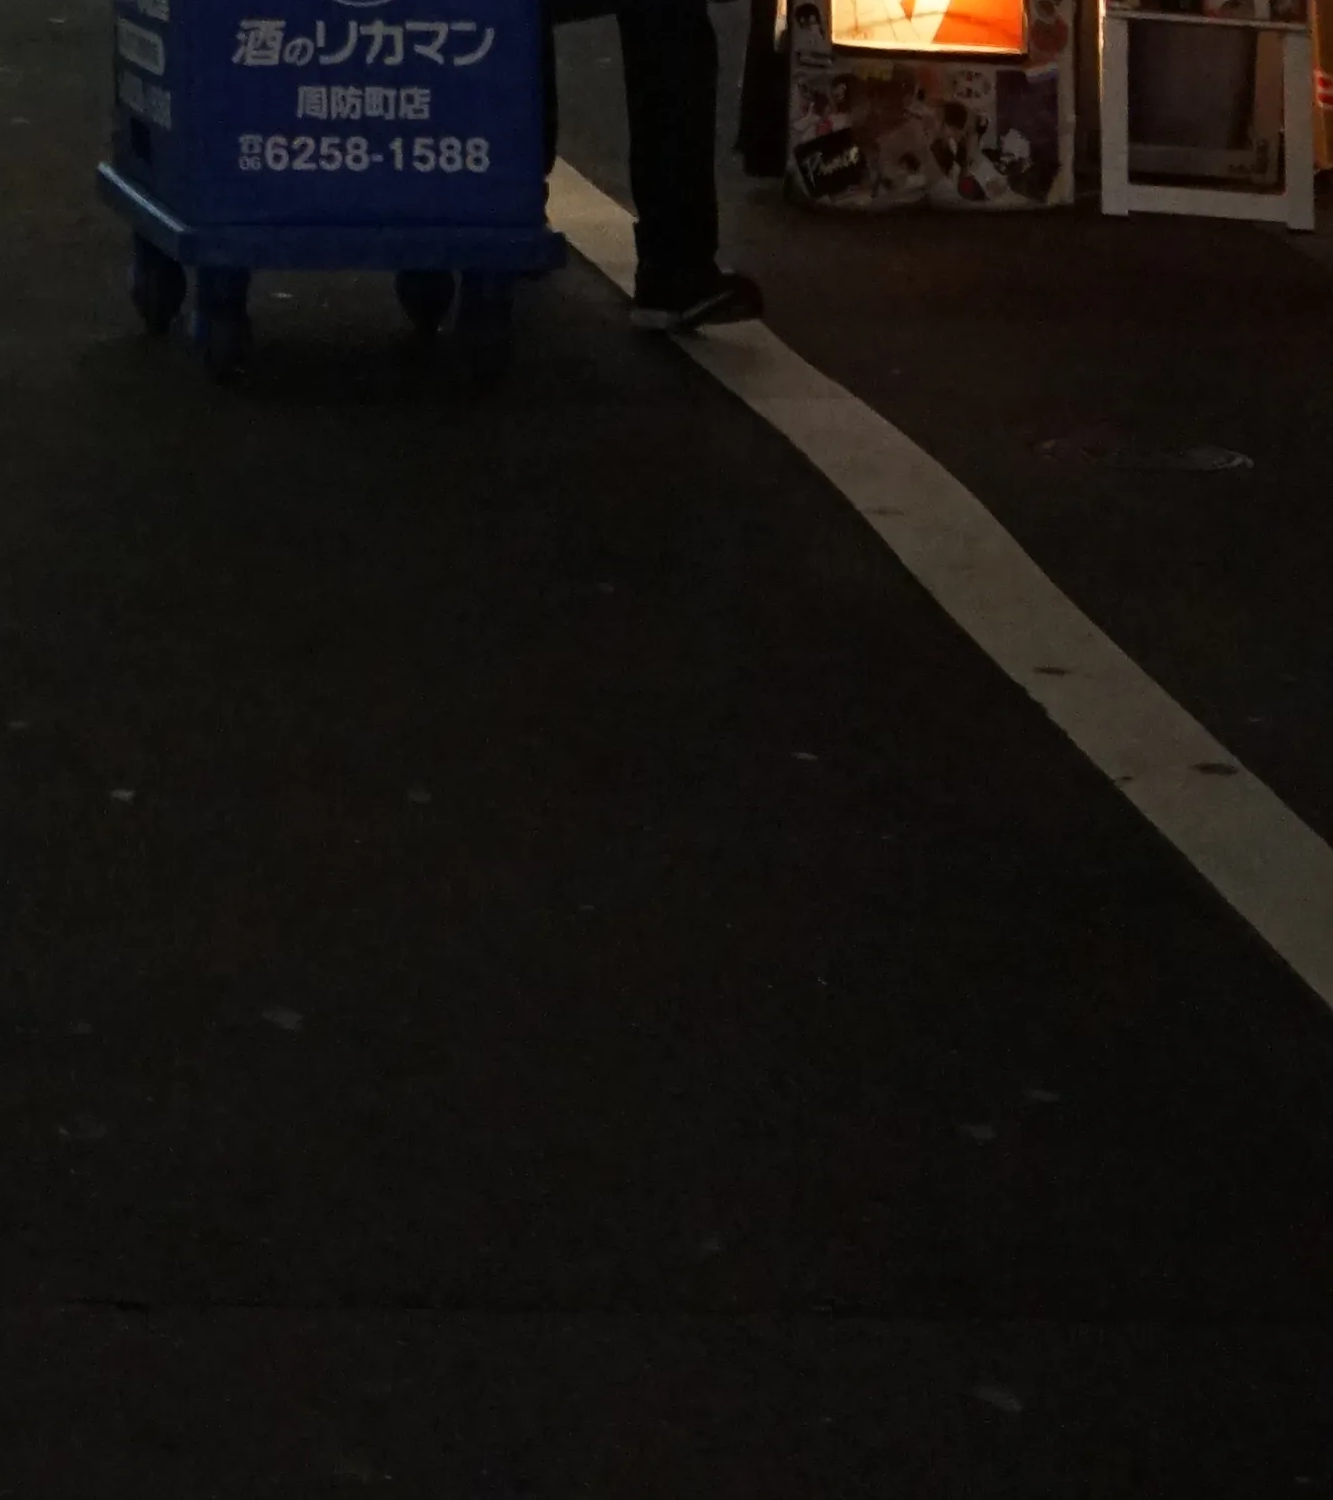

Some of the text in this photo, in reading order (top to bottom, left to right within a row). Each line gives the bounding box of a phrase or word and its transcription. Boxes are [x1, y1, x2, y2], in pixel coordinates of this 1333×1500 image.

[232, 18, 496, 68] 酒のリカマン
[296, 85, 432, 121] 周防町店
[264, 134, 491, 174] 6258-1588
